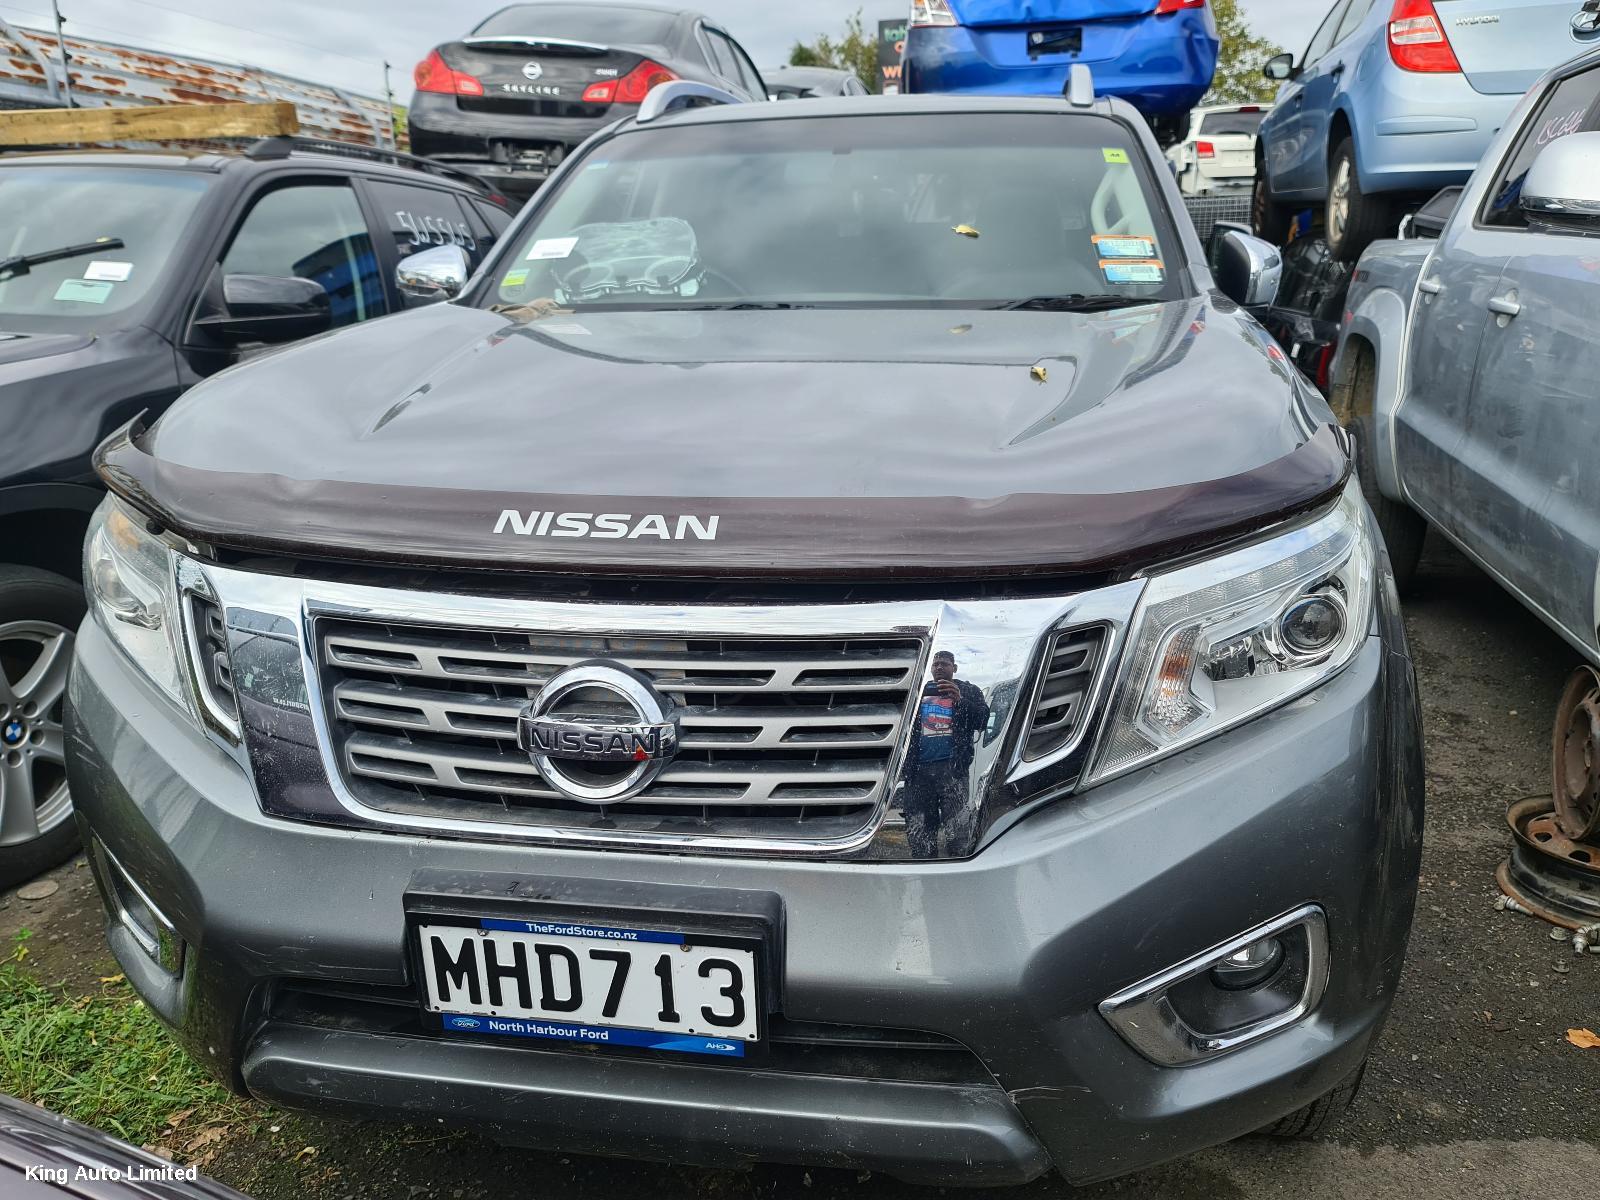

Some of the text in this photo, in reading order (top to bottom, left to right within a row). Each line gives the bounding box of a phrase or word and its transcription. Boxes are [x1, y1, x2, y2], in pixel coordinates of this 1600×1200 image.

[493, 509, 720, 540] NISSAN
[529, 727, 656, 754] NISSAN
[526, 923, 638, 940] TheFordStore.co.nz
[430, 935, 746, 1027] MHD713
[489, 1020, 609, 1040] North Harbour Ford
